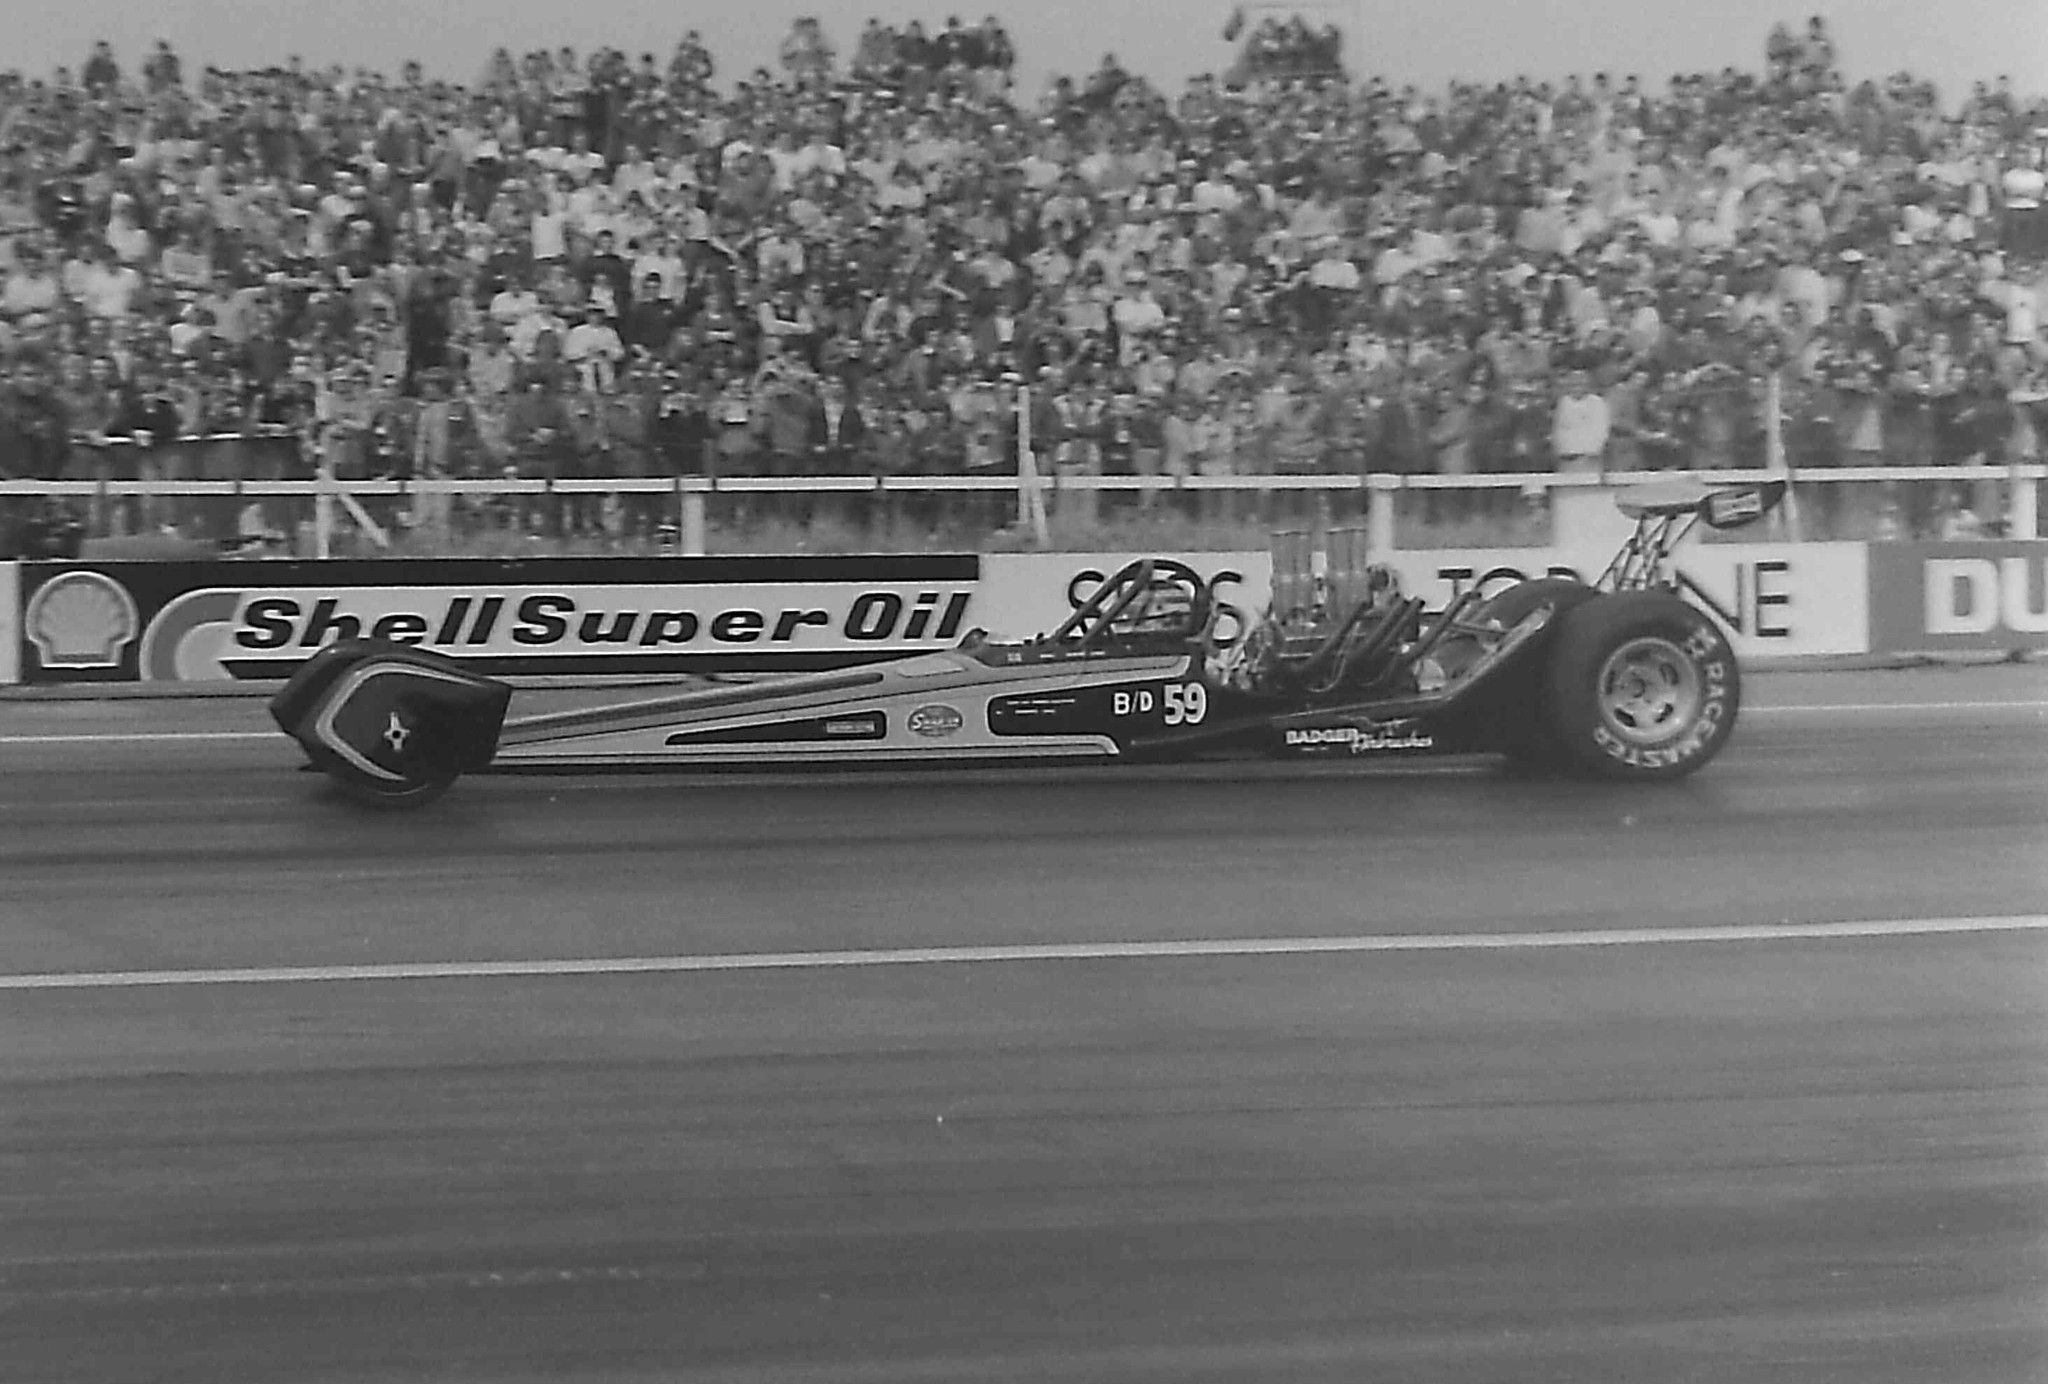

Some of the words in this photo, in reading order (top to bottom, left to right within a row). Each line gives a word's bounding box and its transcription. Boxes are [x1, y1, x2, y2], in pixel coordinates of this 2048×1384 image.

[236, 597, 504, 649] Shell
[512, 595, 828, 646] Super
[844, 591, 970, 641] Oil
[1113, 690, 1154, 715] B/D
[1163, 682, 1207, 725] 59
